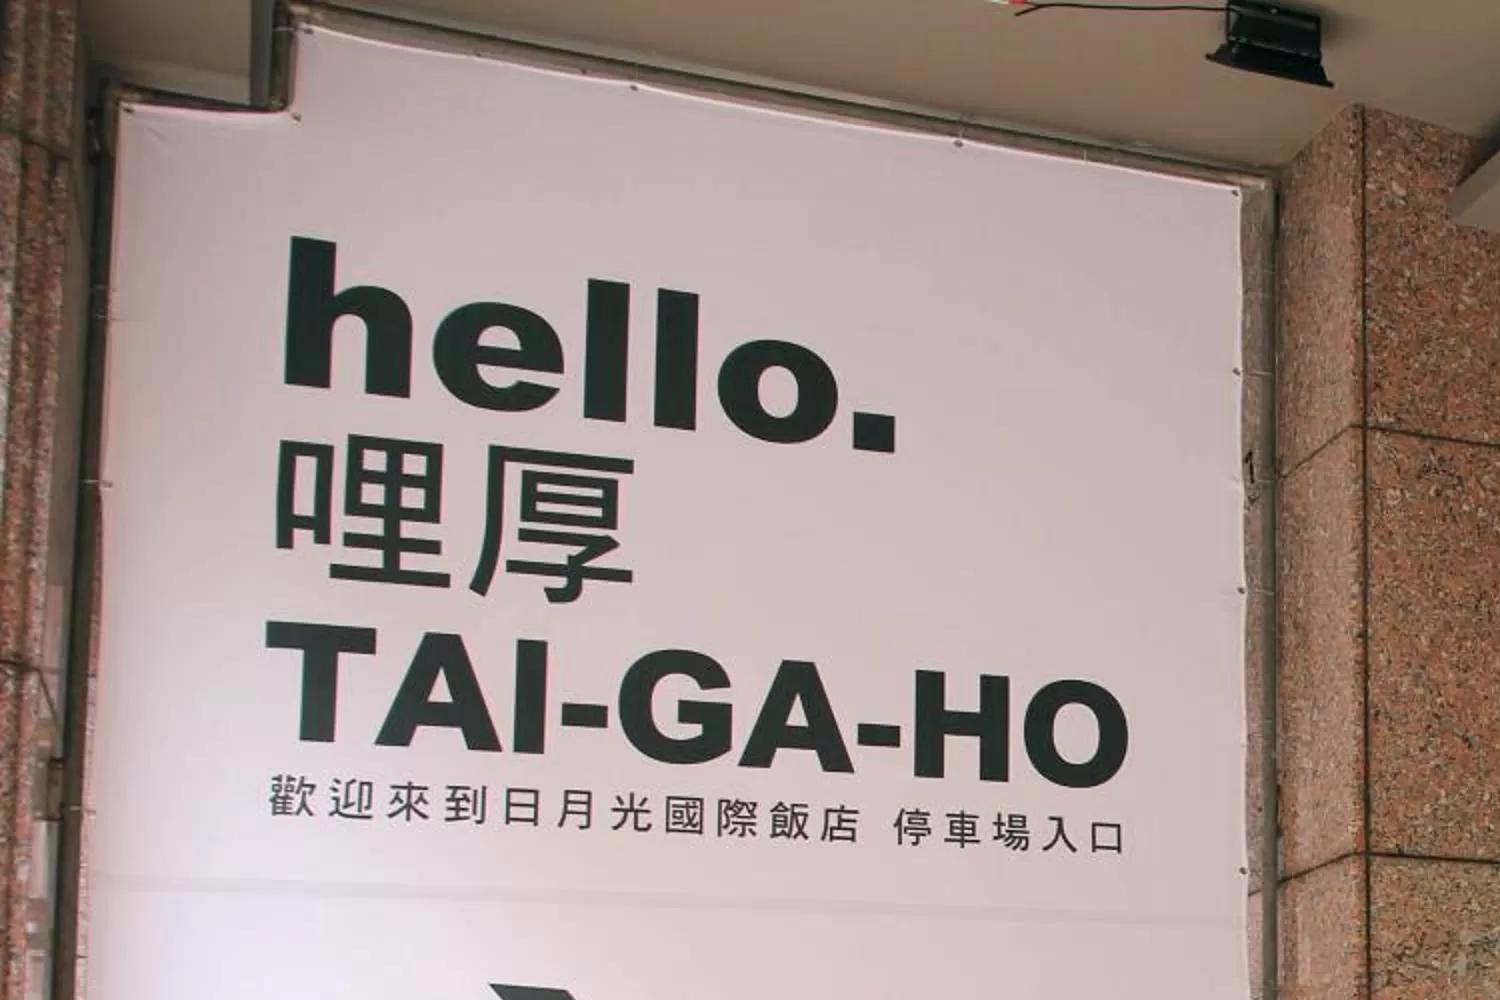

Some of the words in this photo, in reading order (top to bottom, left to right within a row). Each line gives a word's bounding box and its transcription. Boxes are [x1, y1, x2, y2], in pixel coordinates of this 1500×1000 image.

[284, 235, 896, 454] hello.
[275, 433, 635, 604] 哩厚
[265, 620, 1130, 789] TAI-GA-HO
[268, 774, 860, 844] 歡迎來到日月光國際飯店
[892, 806, 1123, 855] 停車場入口
